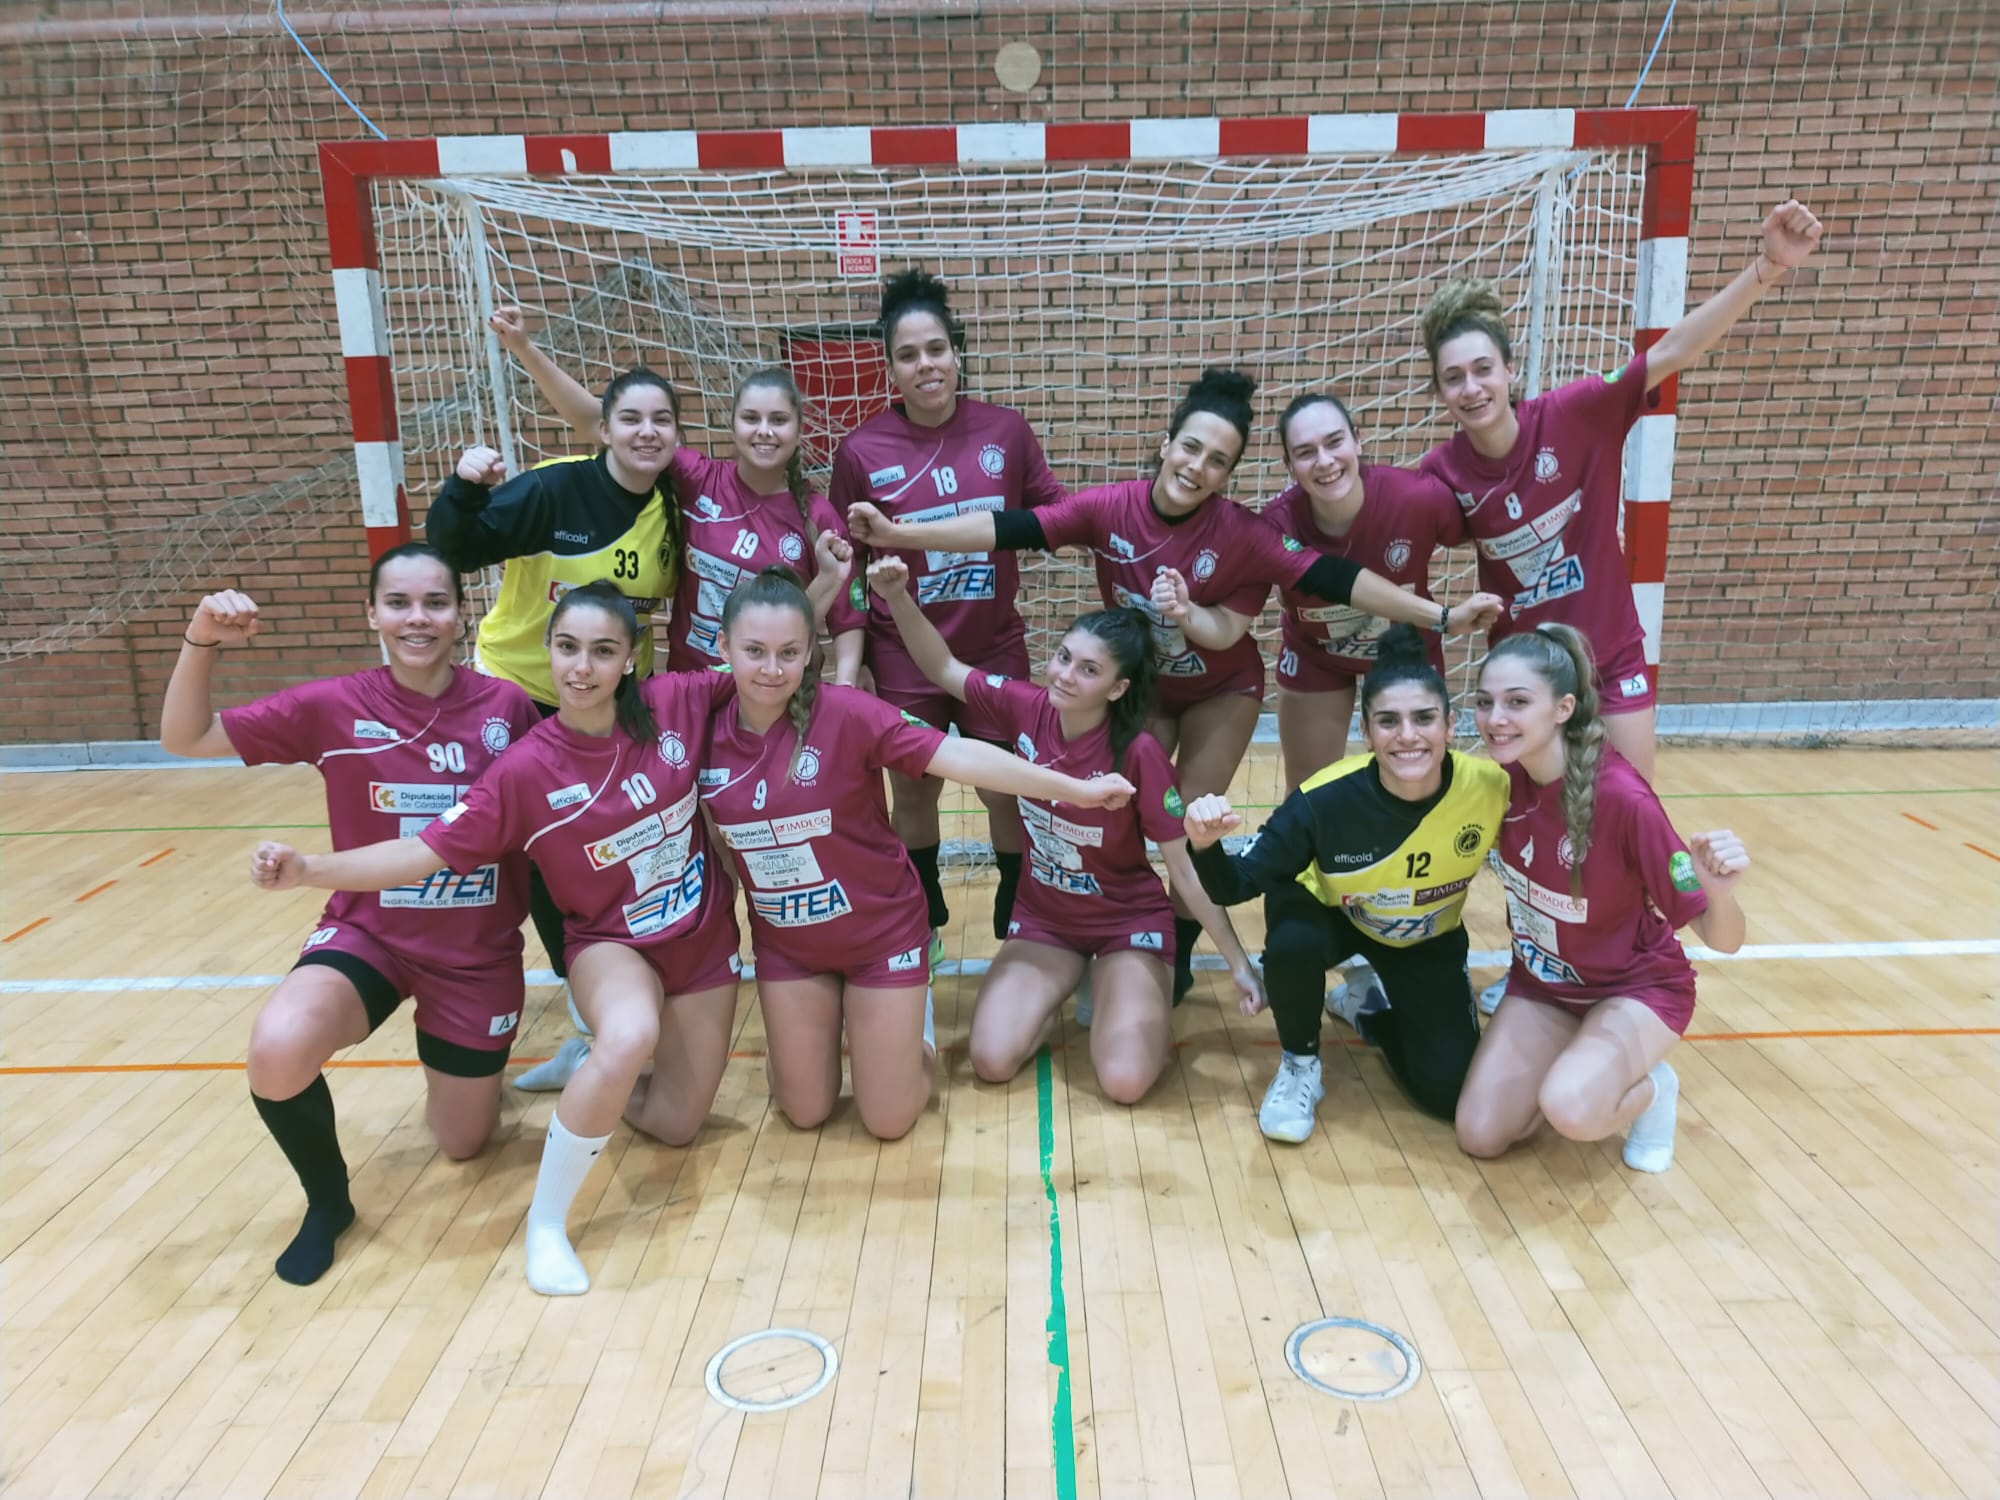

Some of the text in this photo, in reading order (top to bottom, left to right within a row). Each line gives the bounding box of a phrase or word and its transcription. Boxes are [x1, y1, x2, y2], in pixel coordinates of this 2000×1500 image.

[931, 466, 958, 497] 18
[1505, 491, 1523, 520] 8
[730, 528, 759, 559] 19
[613, 548, 639, 580] 33
[1533, 559, 1582, 598] TEA
[939, 567, 994, 595] ITEA
[1156, 653, 1203, 673] TEA
[1280, 648, 1298, 677] 20
[426, 741, 466, 773] 90
[400, 792, 452, 801] Diputación
[620, 773, 657, 811] 10
[752, 778, 767, 810] 9
[616, 823, 660, 847] Diputación
[731, 828, 770, 839] Diputación
[787, 815, 830, 832] IMDECO
[1063, 825, 1100, 839] IMDECO
[1405, 851, 1431, 879] 12
[1520, 835, 1534, 868] 4
[419, 868, 495, 899] ITEA
[781, 884, 846, 920] ITEA
